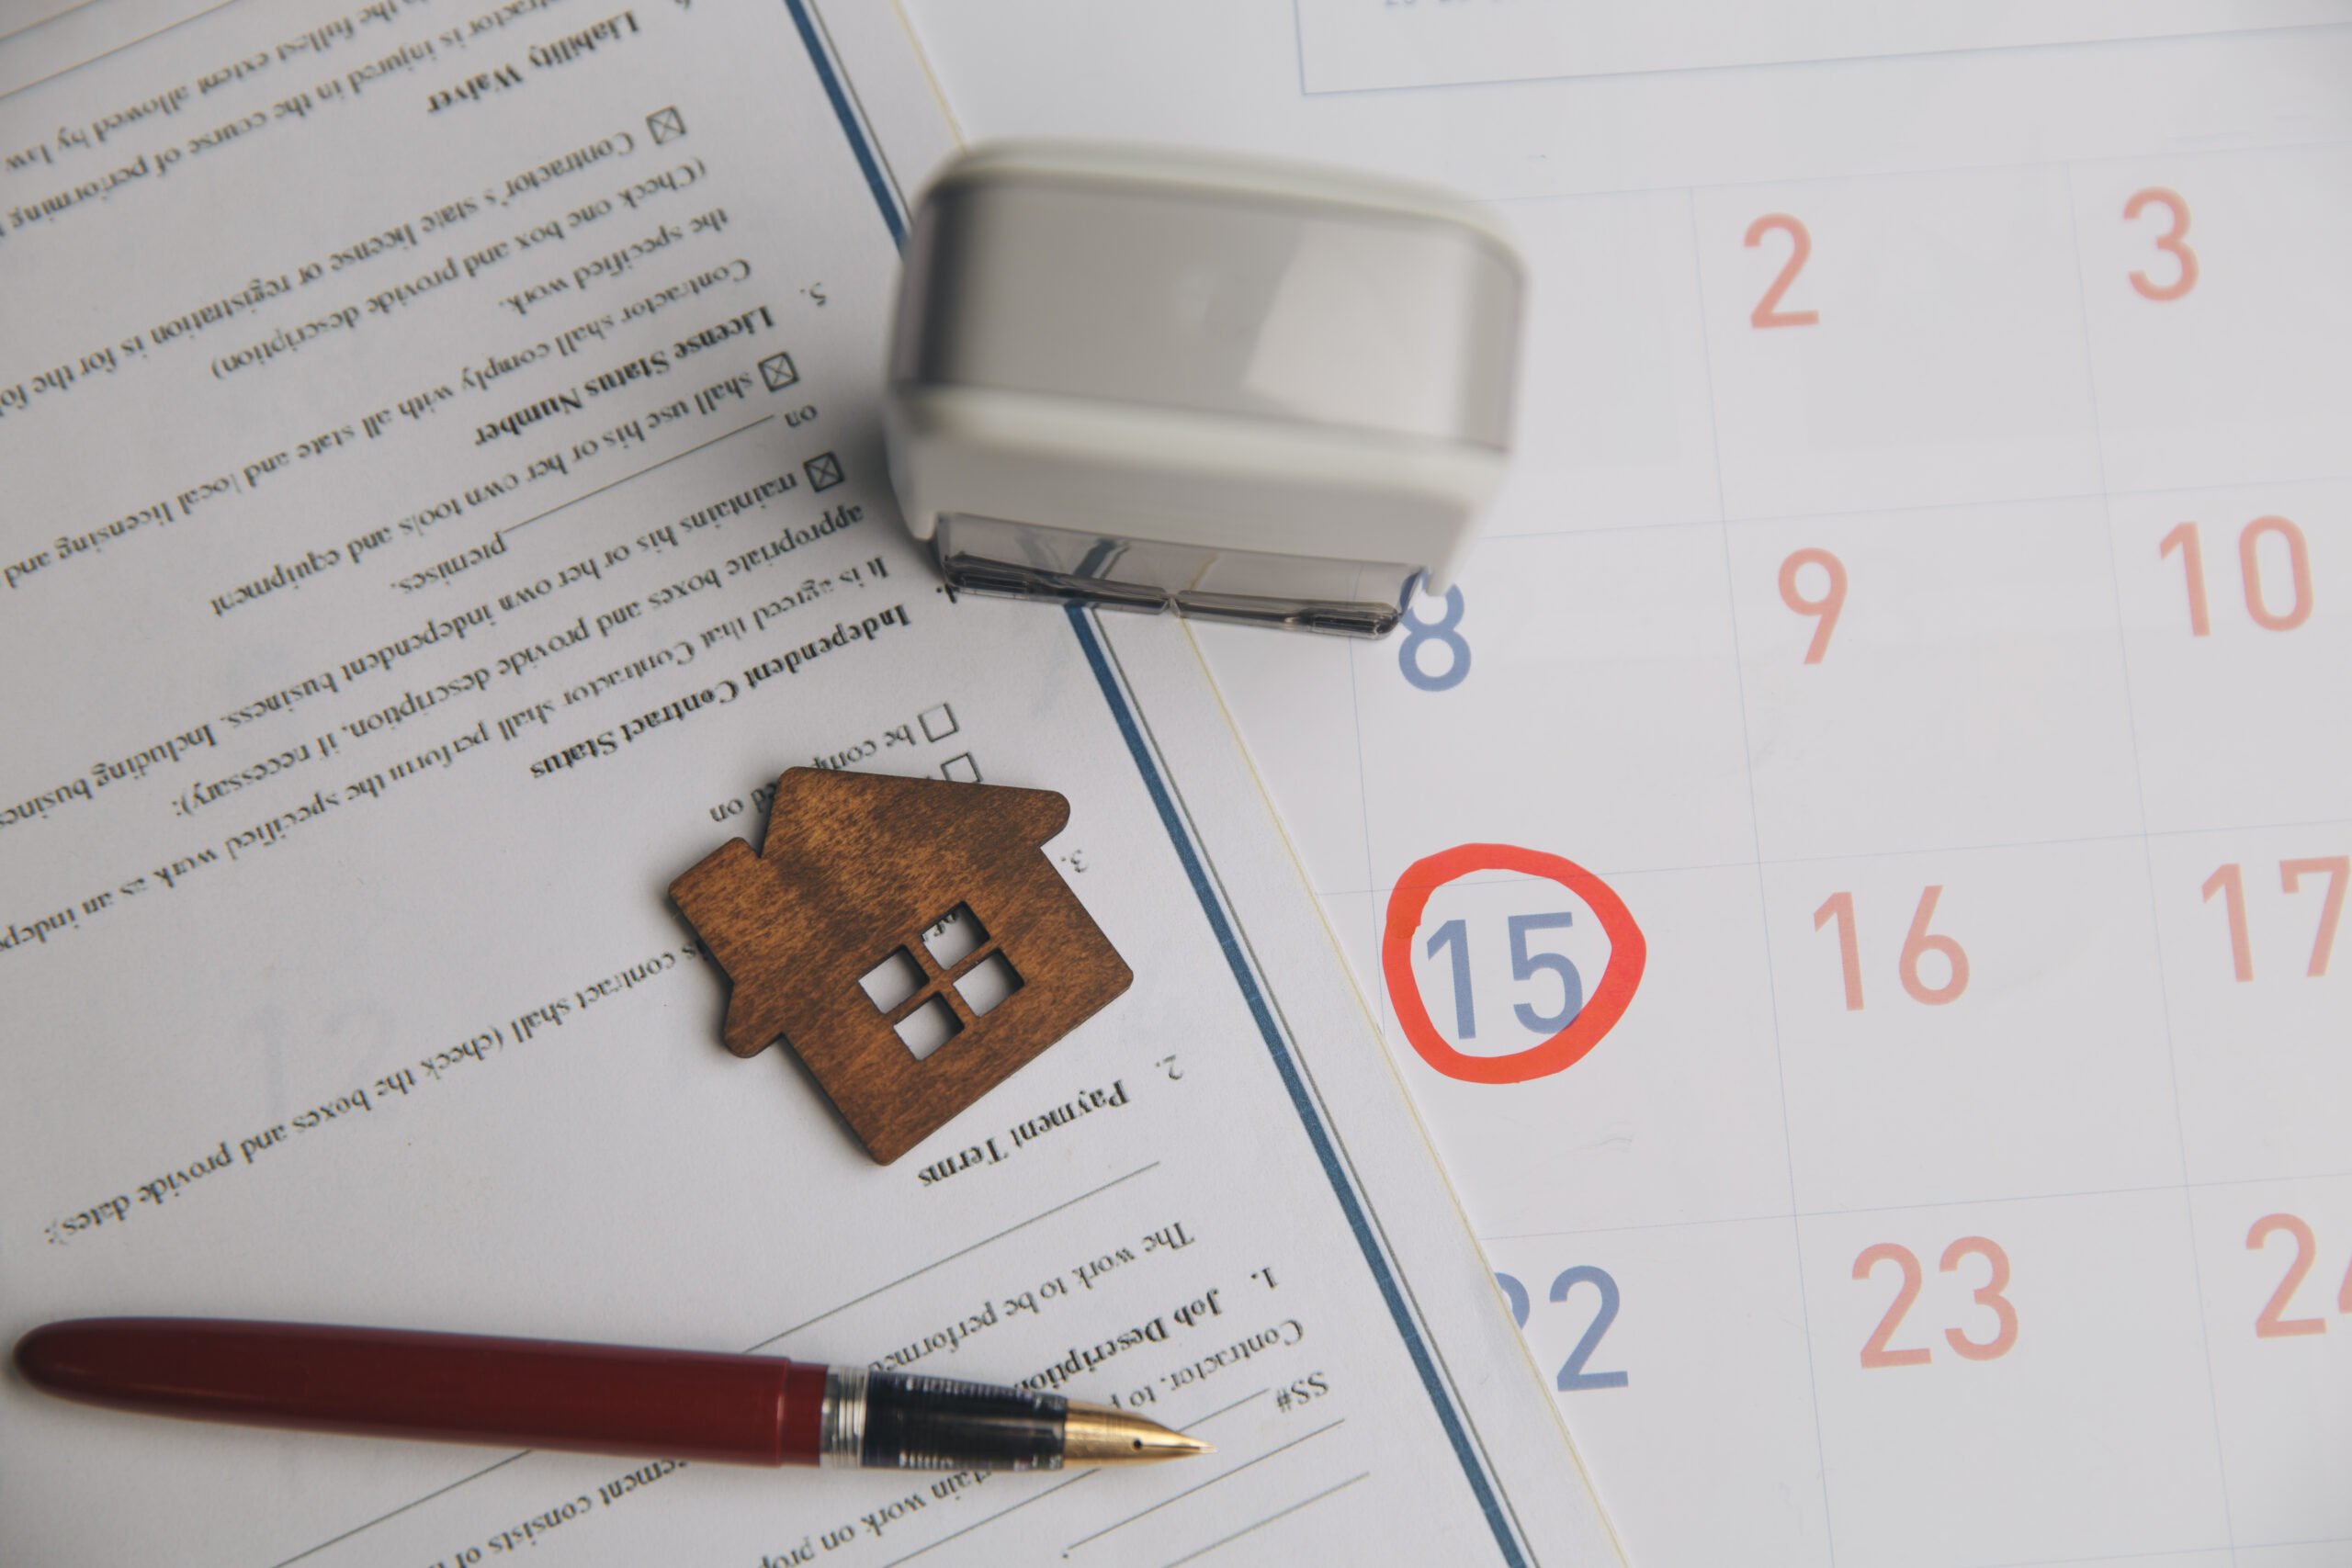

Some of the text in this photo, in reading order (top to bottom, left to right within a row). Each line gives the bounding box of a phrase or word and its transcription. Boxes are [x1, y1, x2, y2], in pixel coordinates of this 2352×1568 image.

[359, 4, 399, 25] the
[276, 17, 356, 62] fullest
[438, 28, 465, 49] is
[197, 52, 271, 96] extent
[346, 40, 437, 96] injured
[427, 10, 641, 115] Liability Waiver
[273, 93, 313, 119] the
[315, 80, 345, 101] in
[92, 85, 189, 143] allowed
[57, 127, 91, 149] by
[153, 148, 183, 177] of
[9, 154, 151, 229] performing
[421, 200, 480, 234] state
[330, 223, 419, 273] license
[498, 208, 729, 317] the specified work.
[2123, 186, 2199, 302] 3
[210, 158, 707, 380] (Check one box and provide description)
[298, 262, 324, 287] or
[1743, 211, 1819, 329] 2
[150, 275, 293, 345] registration
[79, 346, 118, 377] for
[119, 335, 148, 359] is
[474, 281, 828, 447] 5. License Status Number
[31, 364, 76, 394] the
[4, 258, 752, 590] Contractor shall comply with all state and local licensing and
[209, 372, 753, 618] shall use his or her own tools and equipment
[390, 404, 819, 595] on premises.
[678, 472, 798, 533] maintains
[604, 545, 631, 569] or
[636, 525, 680, 554] his
[725, 504, 863, 577] appropriate
[557, 557, 603, 588] her
[647, 568, 723, 610] boxes
[838, 566, 865, 588] is
[865, 556, 890, 580] It
[2159, 515, 2314, 637] 10
[497, 578, 554, 613] own
[751, 579, 834, 631] agreed
[1777, 547, 1848, 665] 9
[594, 601, 643, 638] and
[698, 615, 748, 650] that
[1398, 571, 1472, 693] 8
[339, 604, 497, 683] independent
[496, 615, 592, 677] provide
[528, 603, 912, 780] Independent Contract Status
[562, 640, 696, 707] Contractor
[220, 671, 340, 729] business.
[496, 699, 556, 742] shall
[90, 723, 219, 788] Including
[316, 732, 340, 759] if
[387, 719, 492, 782] perform
[883, 723, 918, 749] be
[171, 743, 312, 817] necessary):
[345, 773, 387, 802] the
[224, 791, 341, 862] specified
[708, 798, 745, 823] on
[1060, 848, 1089, 874] 3.
[81, 891, 114, 916] an
[2201, 855, 2350, 982] 17
[1813, 885, 1970, 1010] 16
[574, 952, 677, 1009] contract
[1427, 911, 1583, 1040] 15
[509, 997, 571, 1044] shall
[419, 1026, 504, 1080] (check
[374, 1067, 417, 1097] the
[290, 1088, 373, 1134] boxes
[917, 1054, 1184, 1189] 2. Payment Terms
[239, 1123, 288, 1166] and
[137, 1141, 234, 1206] provide
[1141, 1221, 1196, 1254] The
[1038, 1276, 1069, 1300] to
[1070, 1246, 1136, 1292] work
[1250, 1266, 1279, 1291] 1.
[1002, 1291, 1041, 1317] be
[1172, 1287, 1224, 1328] Job
[1851, 1235, 2018, 1370] 23
[1128, 1384, 1158, 1419] to
[1275, 1371, 1329, 1414] SS#
[487, 1495, 594, 1553] consists
[820, 1524, 856, 1552] on
[859, 1493, 928, 1538] work
